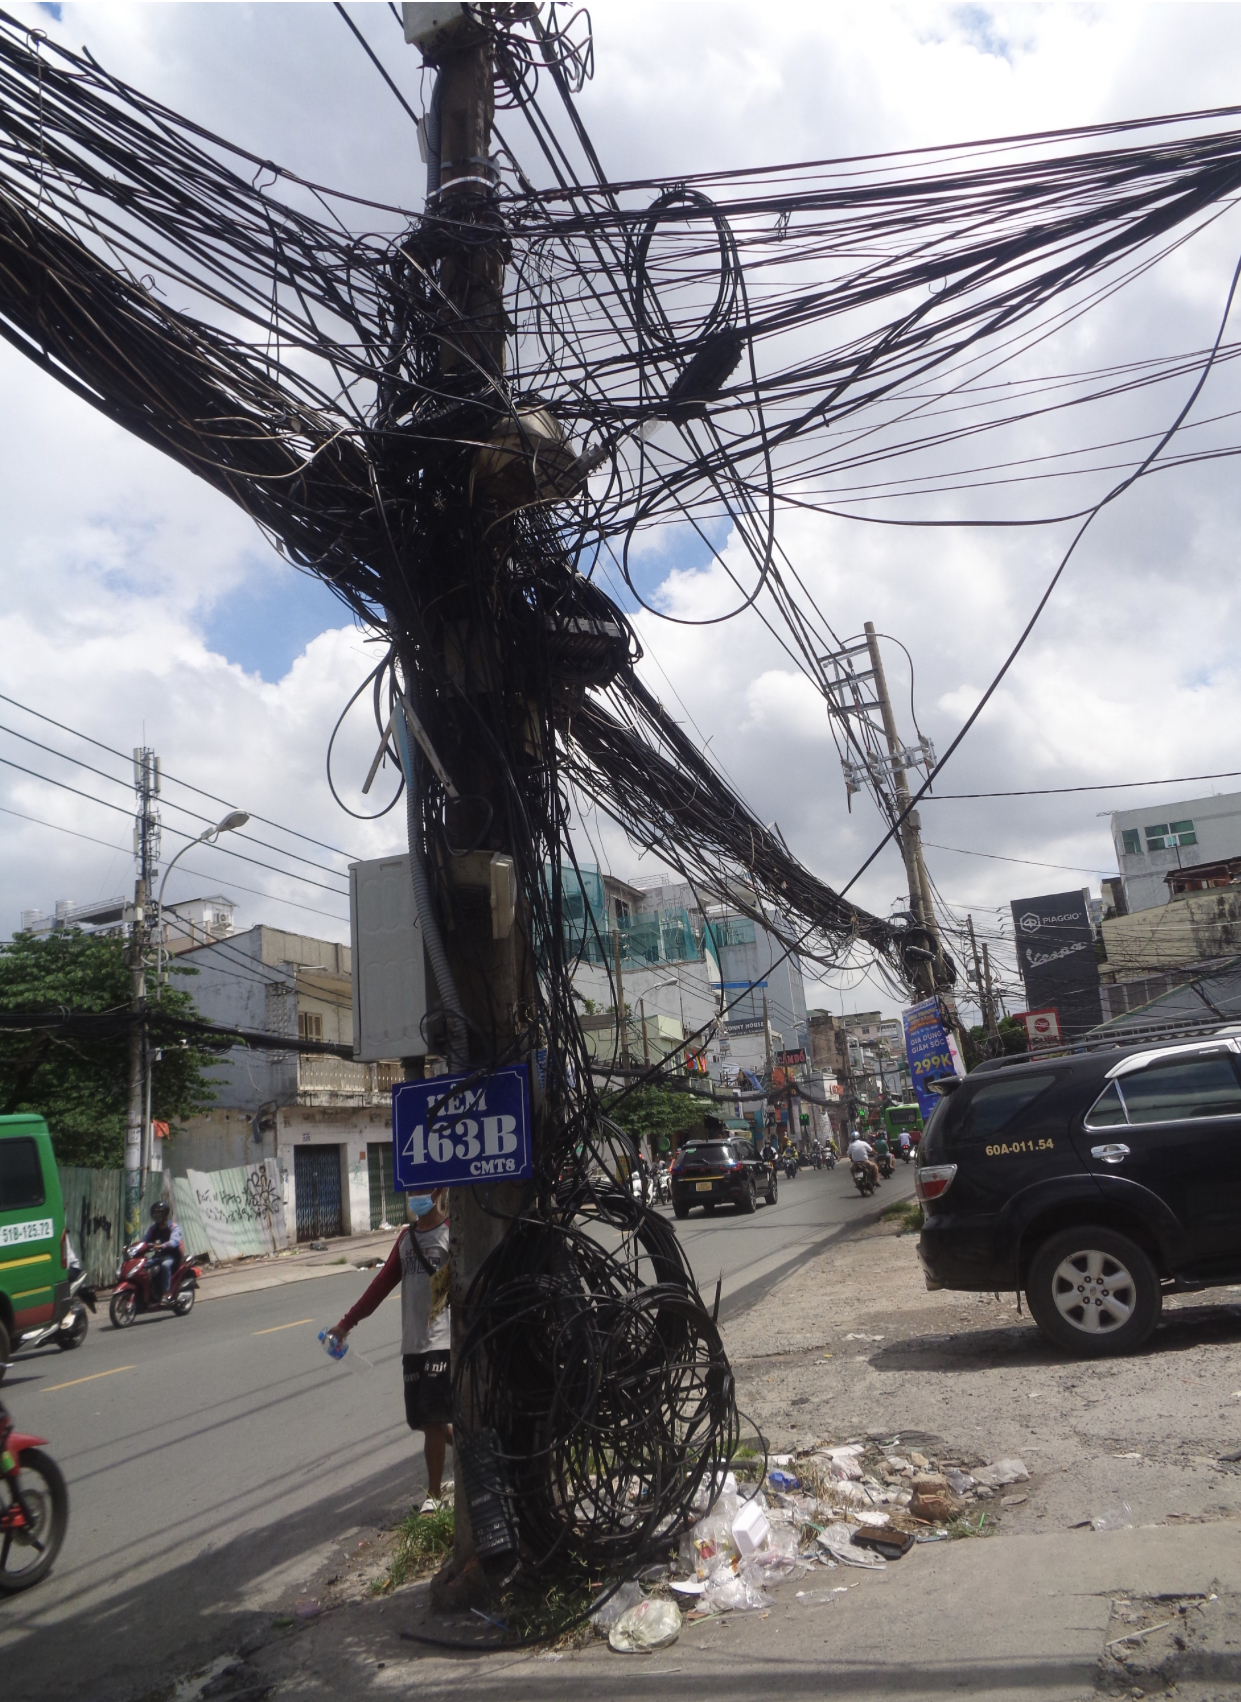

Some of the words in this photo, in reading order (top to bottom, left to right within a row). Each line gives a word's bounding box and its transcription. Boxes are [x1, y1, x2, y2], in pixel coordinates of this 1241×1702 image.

[1042, 912, 1079, 924] PIAGGIO
[913, 1052, 952, 1075] 299K
[402, 1115, 517, 1165] 463B
[985, 1138, 1054, 1156] 60A-011.54
[470, 1158, 516, 1175] CMT8
[3, 1222, 50, 1243] 51B-125.72
